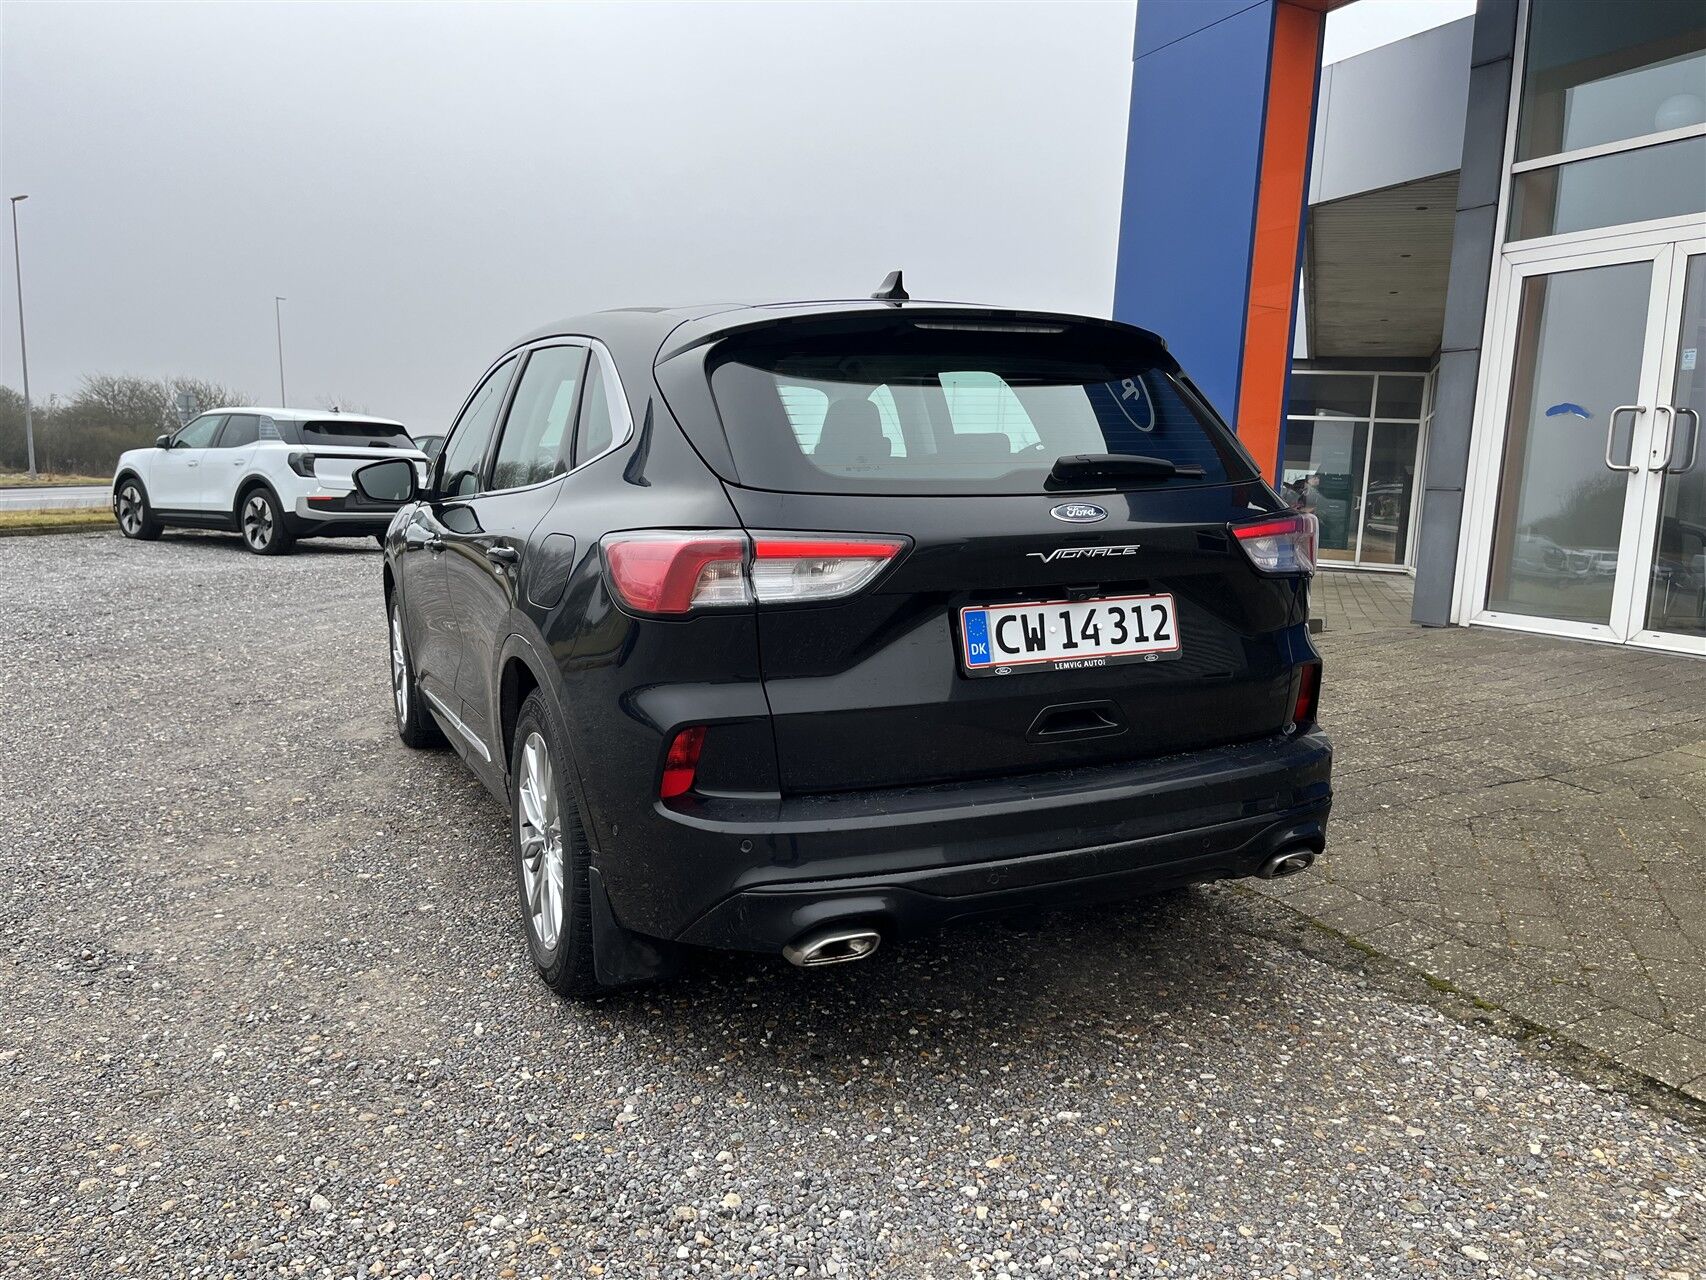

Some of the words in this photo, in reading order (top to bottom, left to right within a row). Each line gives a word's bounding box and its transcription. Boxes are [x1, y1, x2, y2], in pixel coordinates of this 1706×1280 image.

[1066, 505, 1096, 517] Ford
[1026, 544, 1140, 563] VIGNALE
[996, 614, 1046, 654] CW
[1059, 605, 1170, 649] 14312
[971, 643, 987, 655] DK
[1055, 661, 1082, 670] LEMVIG
